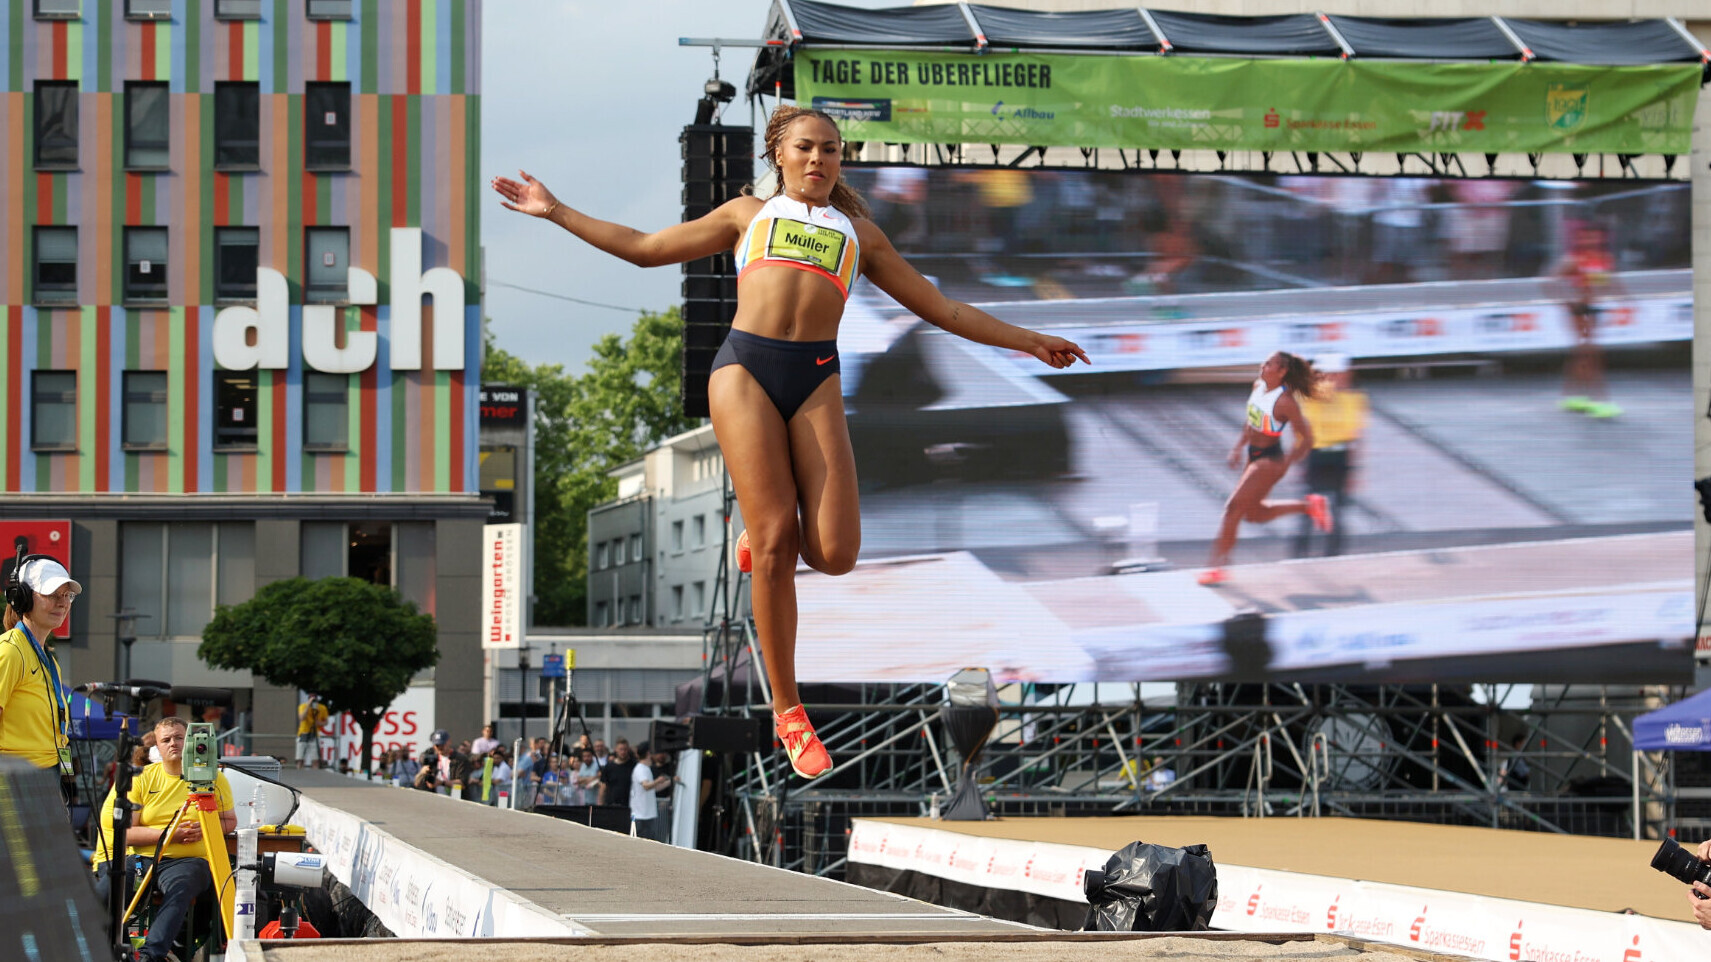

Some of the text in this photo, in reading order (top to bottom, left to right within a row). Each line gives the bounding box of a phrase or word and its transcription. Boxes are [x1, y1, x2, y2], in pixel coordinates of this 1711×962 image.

[810, 59, 1052, 88] TAGE DER ÜBERFLIEGER
[1013, 108, 1055, 120] Allbau
[785, 232, 829, 253] Müller
[492, 391, 519, 402] VON
[490, 540, 506, 642] Weingarten
[319, 710, 418, 736] GRSS
